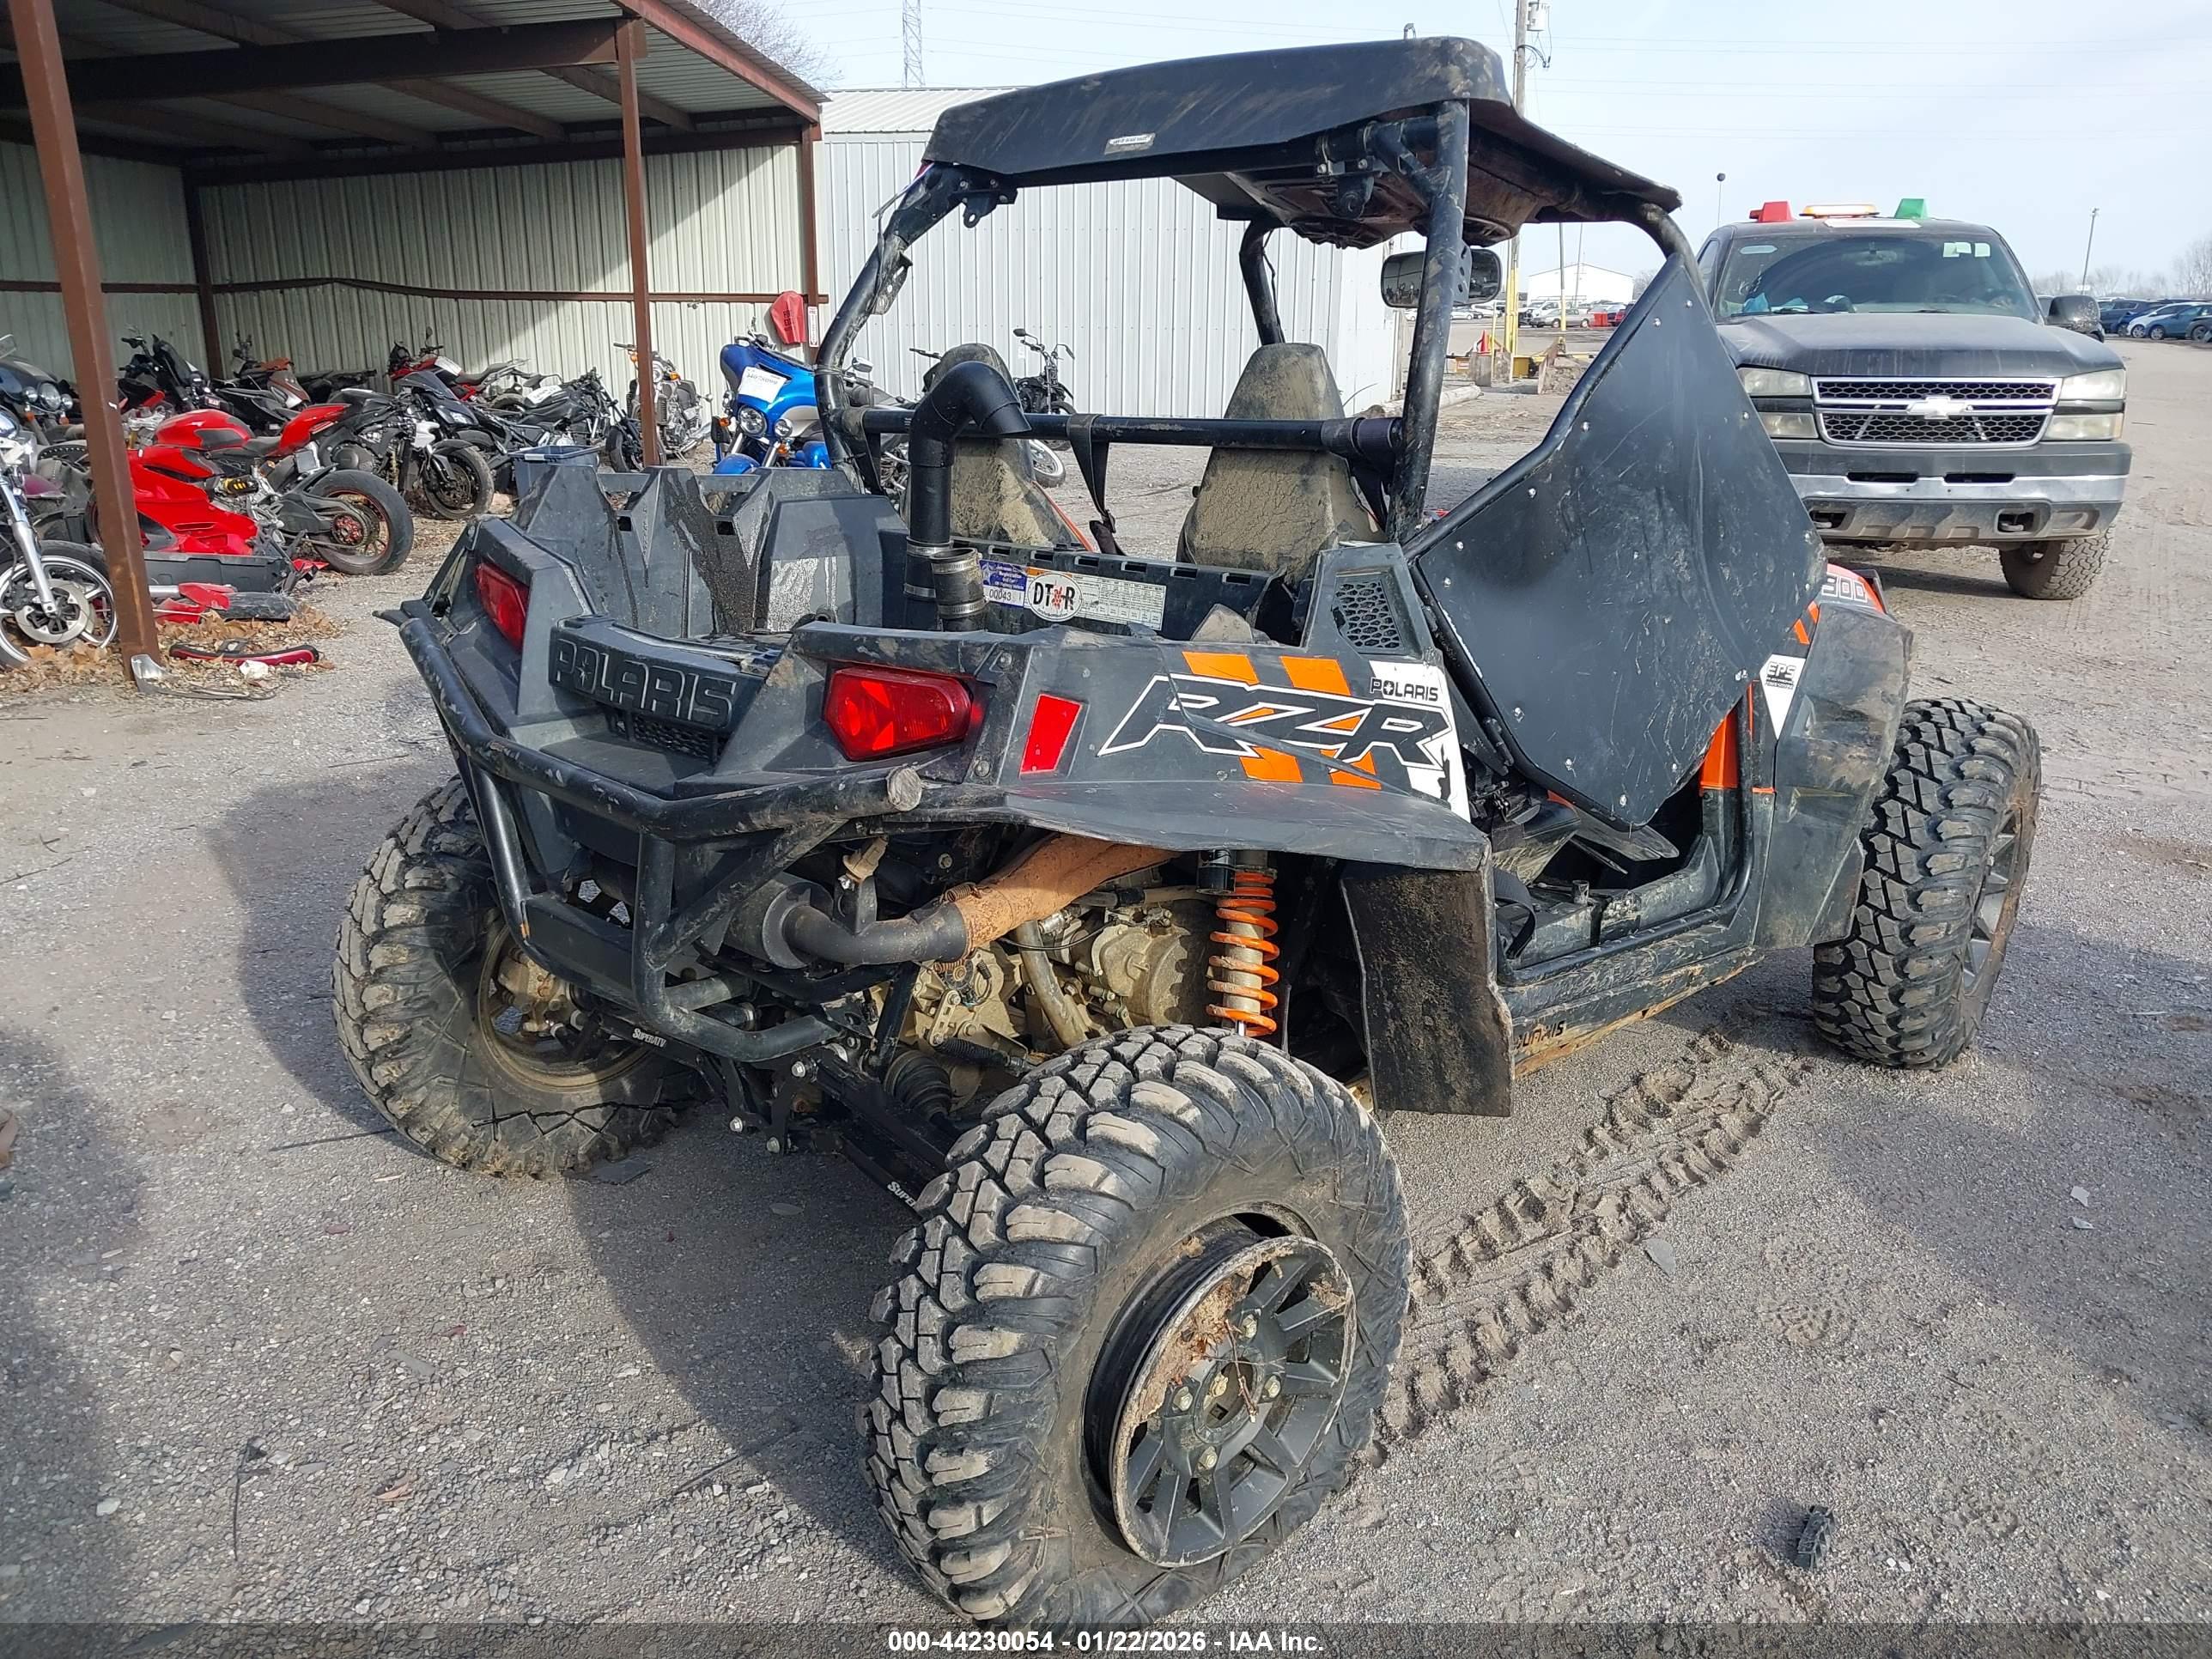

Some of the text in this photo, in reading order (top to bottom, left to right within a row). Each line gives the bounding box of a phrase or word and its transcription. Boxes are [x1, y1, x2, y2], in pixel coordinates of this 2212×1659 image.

[989, 589, 1012, 601] 00043
[1767, 661, 1796, 680] EPS
[555, 638, 738, 730] POLARIS
[1370, 677, 1438, 702] POLARIS
[1097, 673, 1453, 777] RZR
